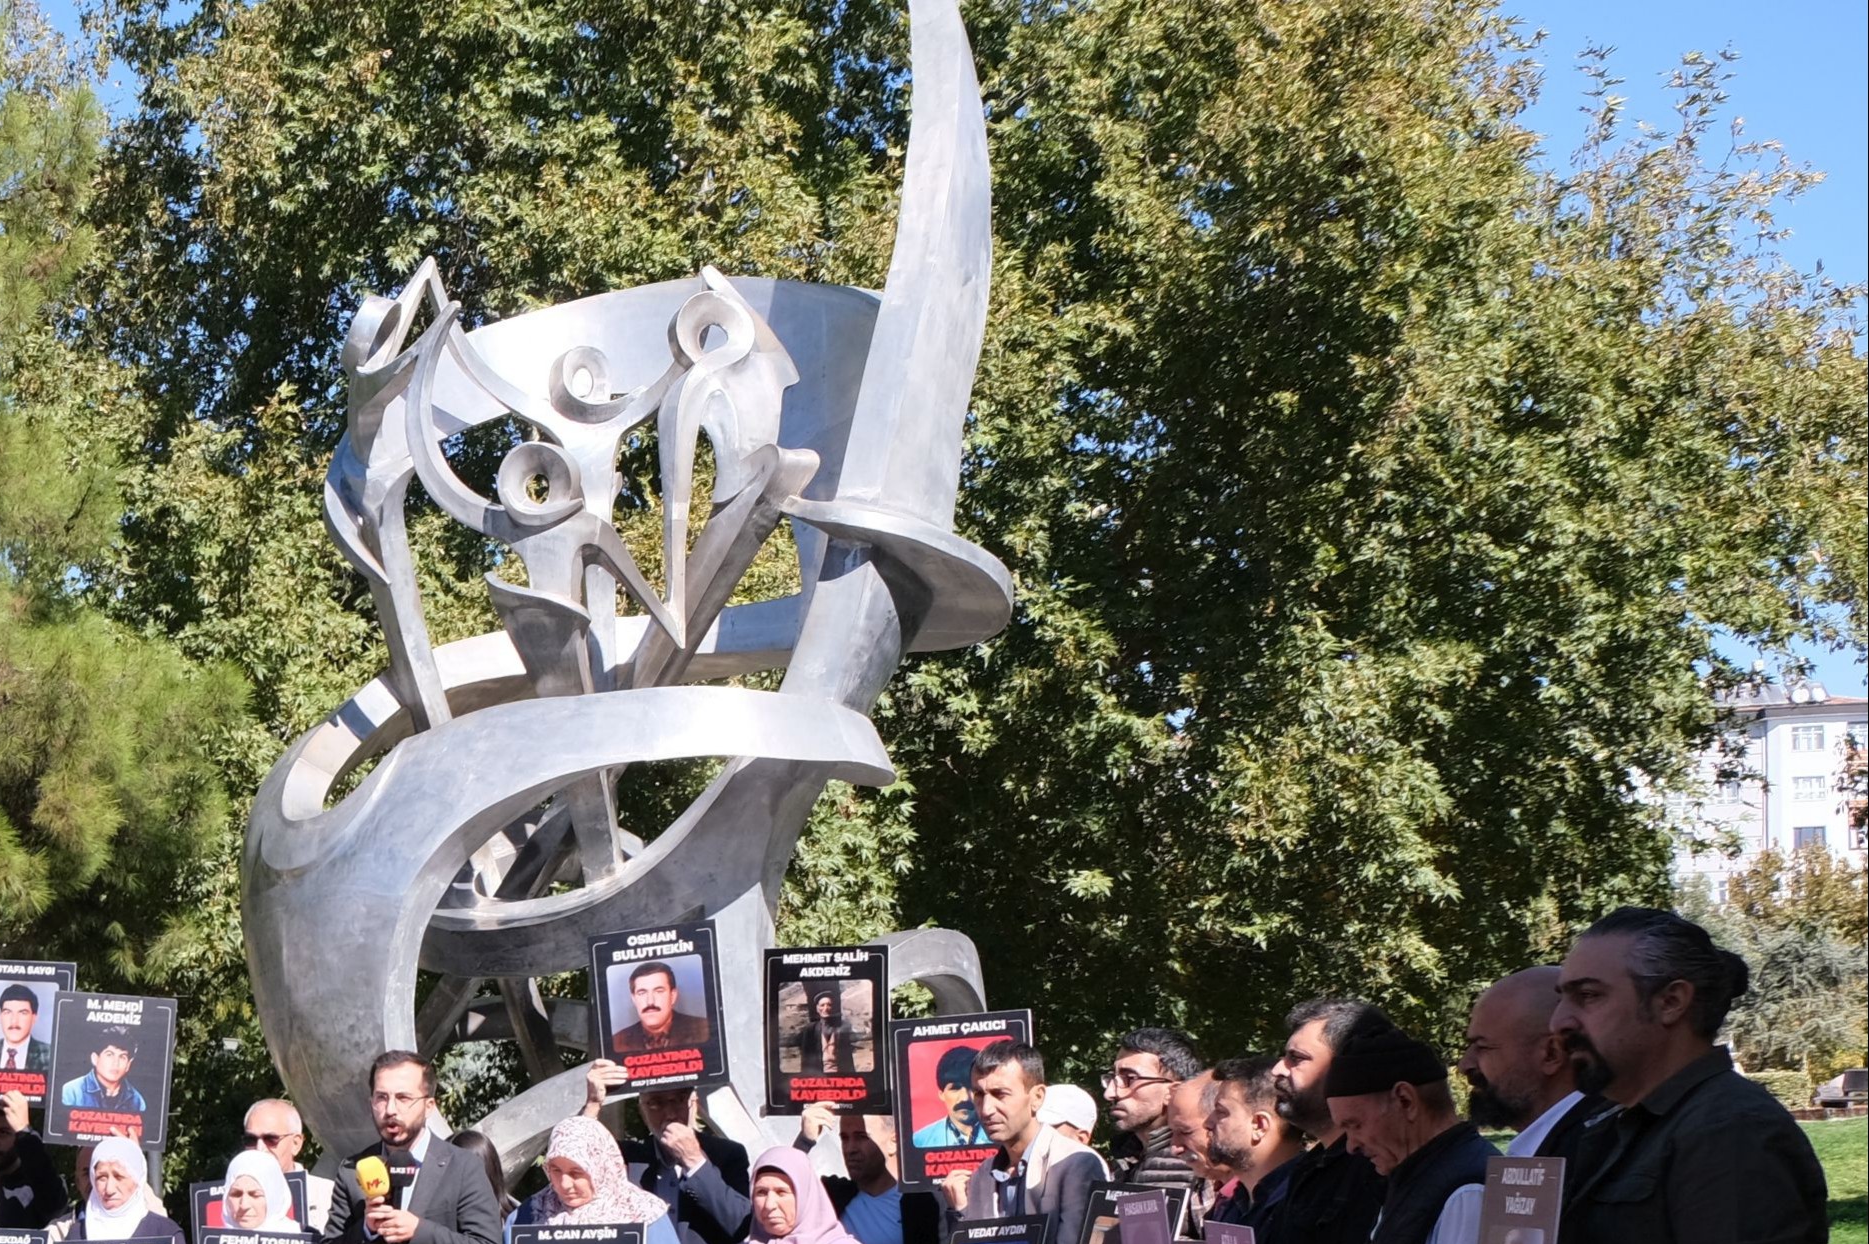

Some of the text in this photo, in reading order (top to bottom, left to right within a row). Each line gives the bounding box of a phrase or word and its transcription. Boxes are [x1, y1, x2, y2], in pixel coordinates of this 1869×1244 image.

[626, 929, 677, 948] OSMAN
[612, 939, 694, 963] BULUTTEKİN
[782, 950, 869, 965] MEHMET SALİH
[26, 965, 56, 976] SAYGI
[799, 964, 851, 978] AKDENİZ
[86, 998, 144, 1013] M. MEHDİ
[86, 1009, 142, 1025] AKDENİZ
[912, 1018, 1007, 1037] AHMET ÇAKICI
[538, 1226, 618, 1242] M. CAN AYŞİN
[967, 1223, 1027, 1239] VEDAT AYDIN
